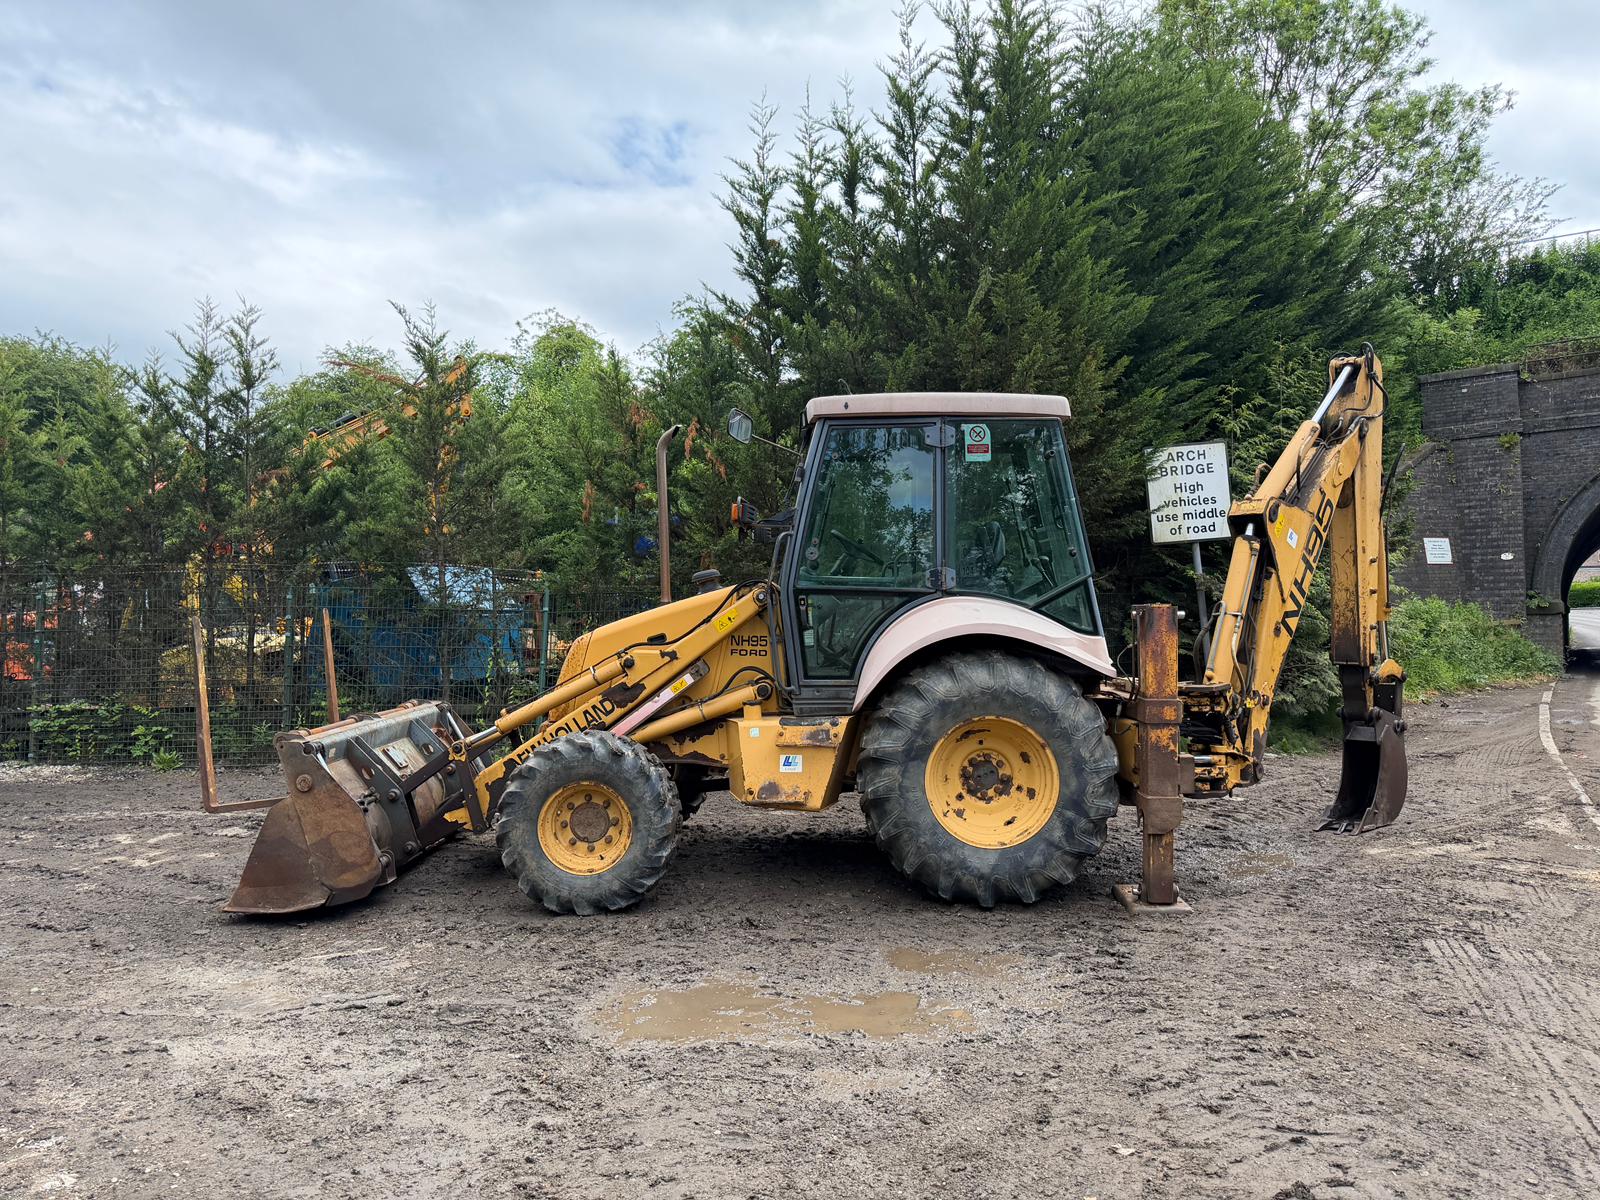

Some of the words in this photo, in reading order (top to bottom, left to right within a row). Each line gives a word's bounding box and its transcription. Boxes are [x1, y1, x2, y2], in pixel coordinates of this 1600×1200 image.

[1167, 450, 1206, 462] ARCH
[1160, 463, 1214, 477] BRIDGE
[1174, 482, 1203, 494] High
[1164, 496, 1217, 508] vehicles
[1157, 513, 1178, 522] use
[1183, 508, 1226, 520] middle
[1170, 526, 1182, 535] of
[1187, 522, 1216, 534] road
[1280, 487, 1334, 638] NH95
[730, 635, 768, 647] NH95
